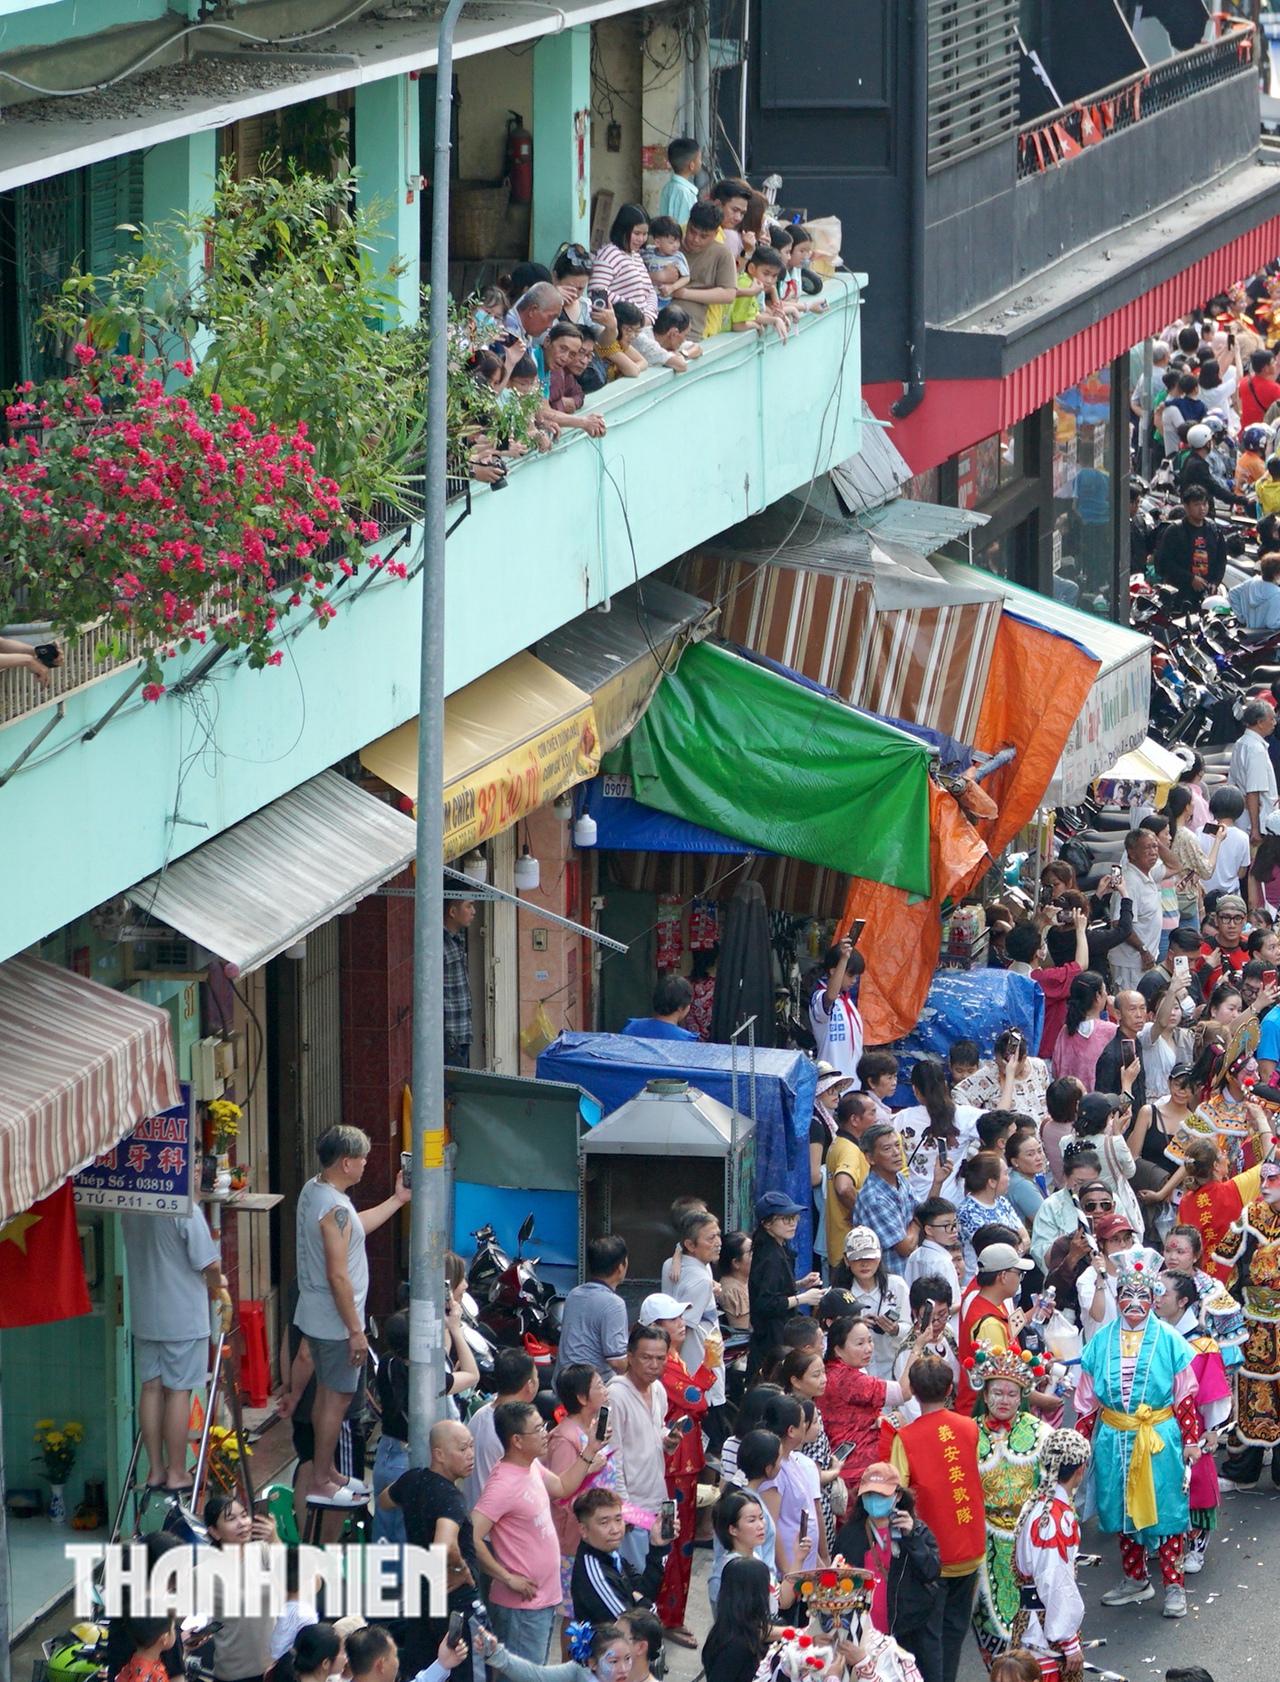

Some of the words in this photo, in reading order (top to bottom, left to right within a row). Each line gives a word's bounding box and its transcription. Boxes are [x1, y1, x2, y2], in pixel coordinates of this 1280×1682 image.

[108, 1172, 126, 1188] Số
[136, 1179, 173, 1192] 03819
[86, 1190, 106, 1204] TỬ
[156, 1198, 178, 1210] Q.5
[938, 1424, 973, 1525] 義安英歌隊
